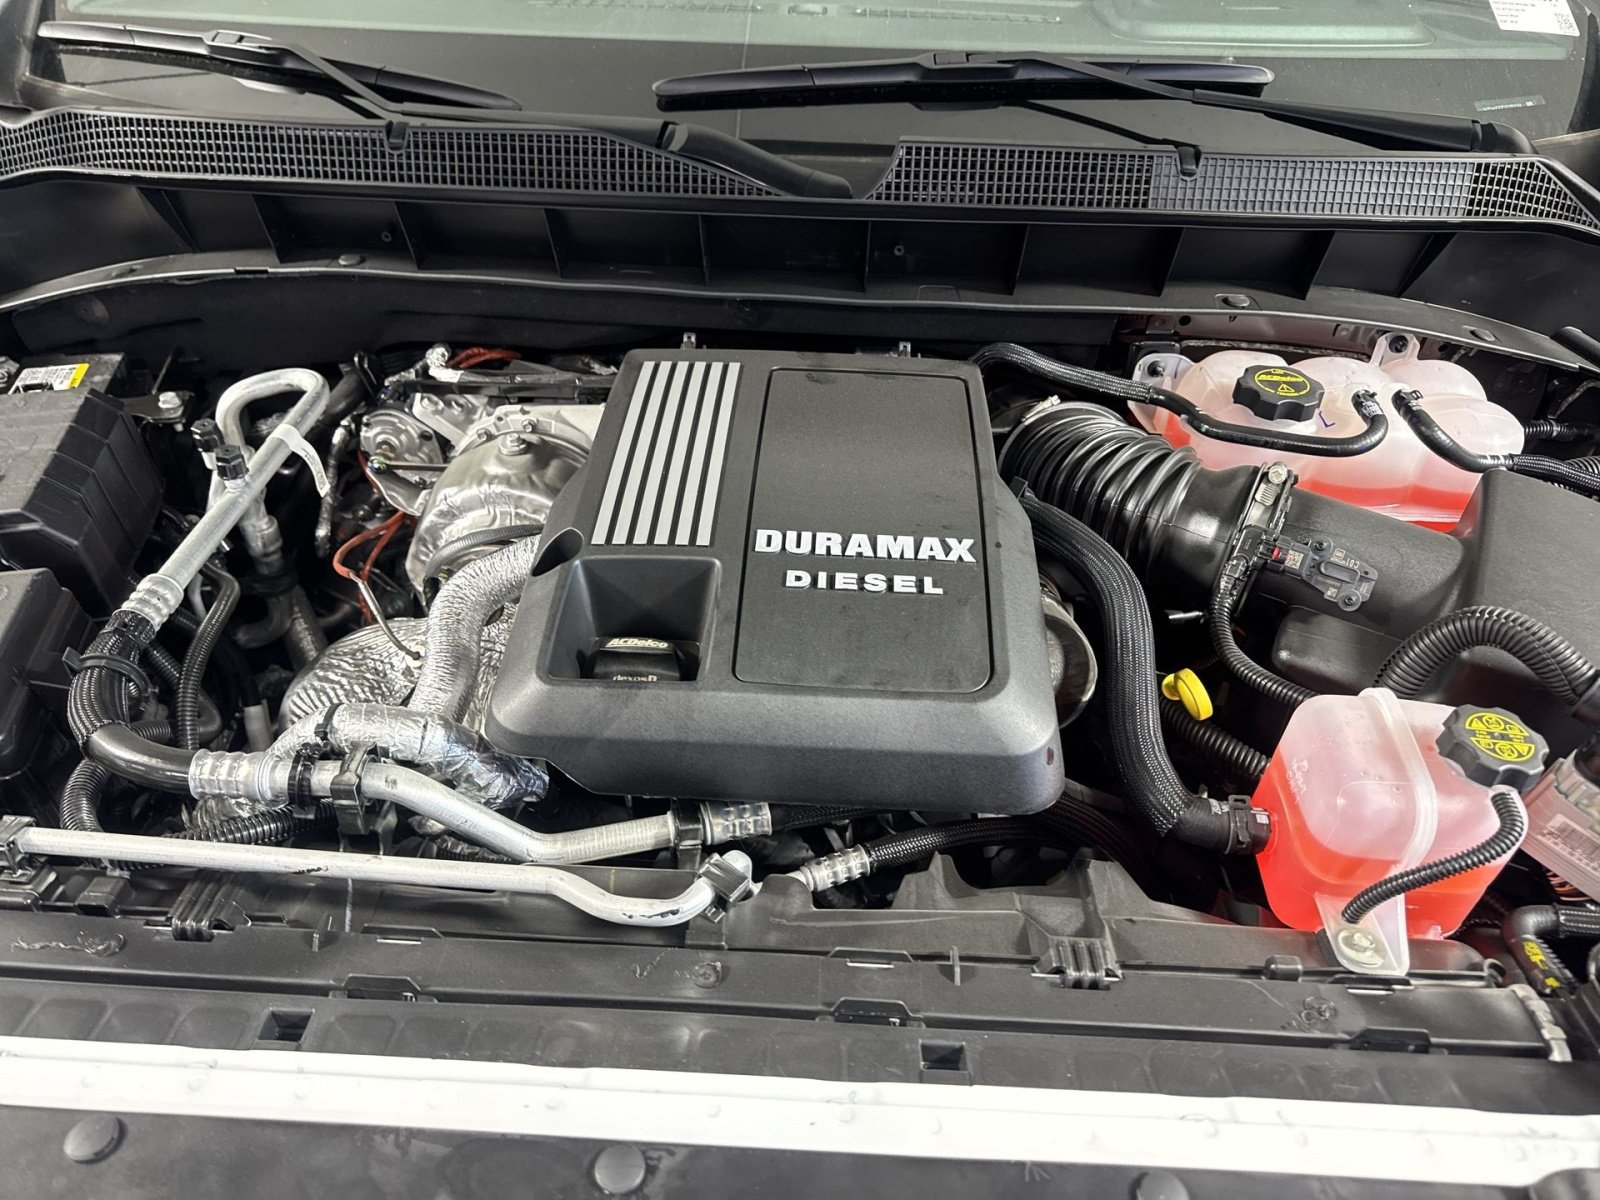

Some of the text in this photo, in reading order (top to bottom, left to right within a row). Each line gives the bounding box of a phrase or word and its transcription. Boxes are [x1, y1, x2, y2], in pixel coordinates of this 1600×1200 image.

[754, 529, 977, 563] DURAMAX
[785, 569, 944, 595] DIESEL
[605, 638, 669, 649] ACDelco
